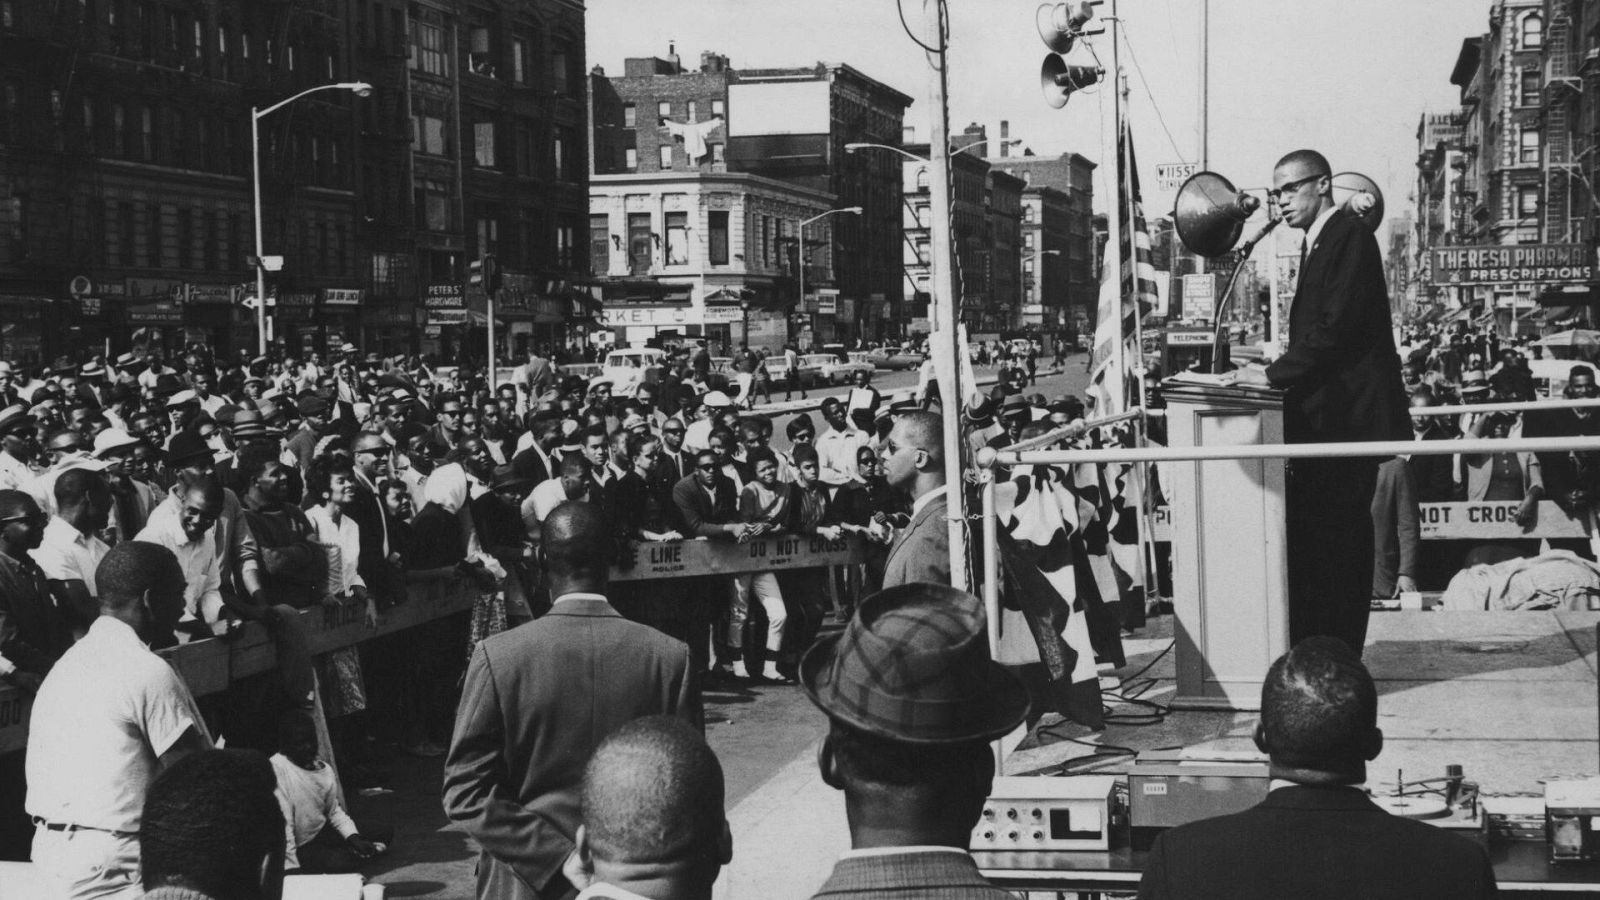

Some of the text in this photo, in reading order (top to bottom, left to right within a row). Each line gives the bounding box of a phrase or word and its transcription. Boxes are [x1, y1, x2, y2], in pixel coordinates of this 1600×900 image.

[1437, 249, 1511, 269] THERESA
[1470, 266, 1591, 281] PRESCRIPTIONS
[1468, 506, 1519, 523] CROS
[651, 546, 682, 564] LINE
[750, 537, 848, 558] DO NOT CROSS
